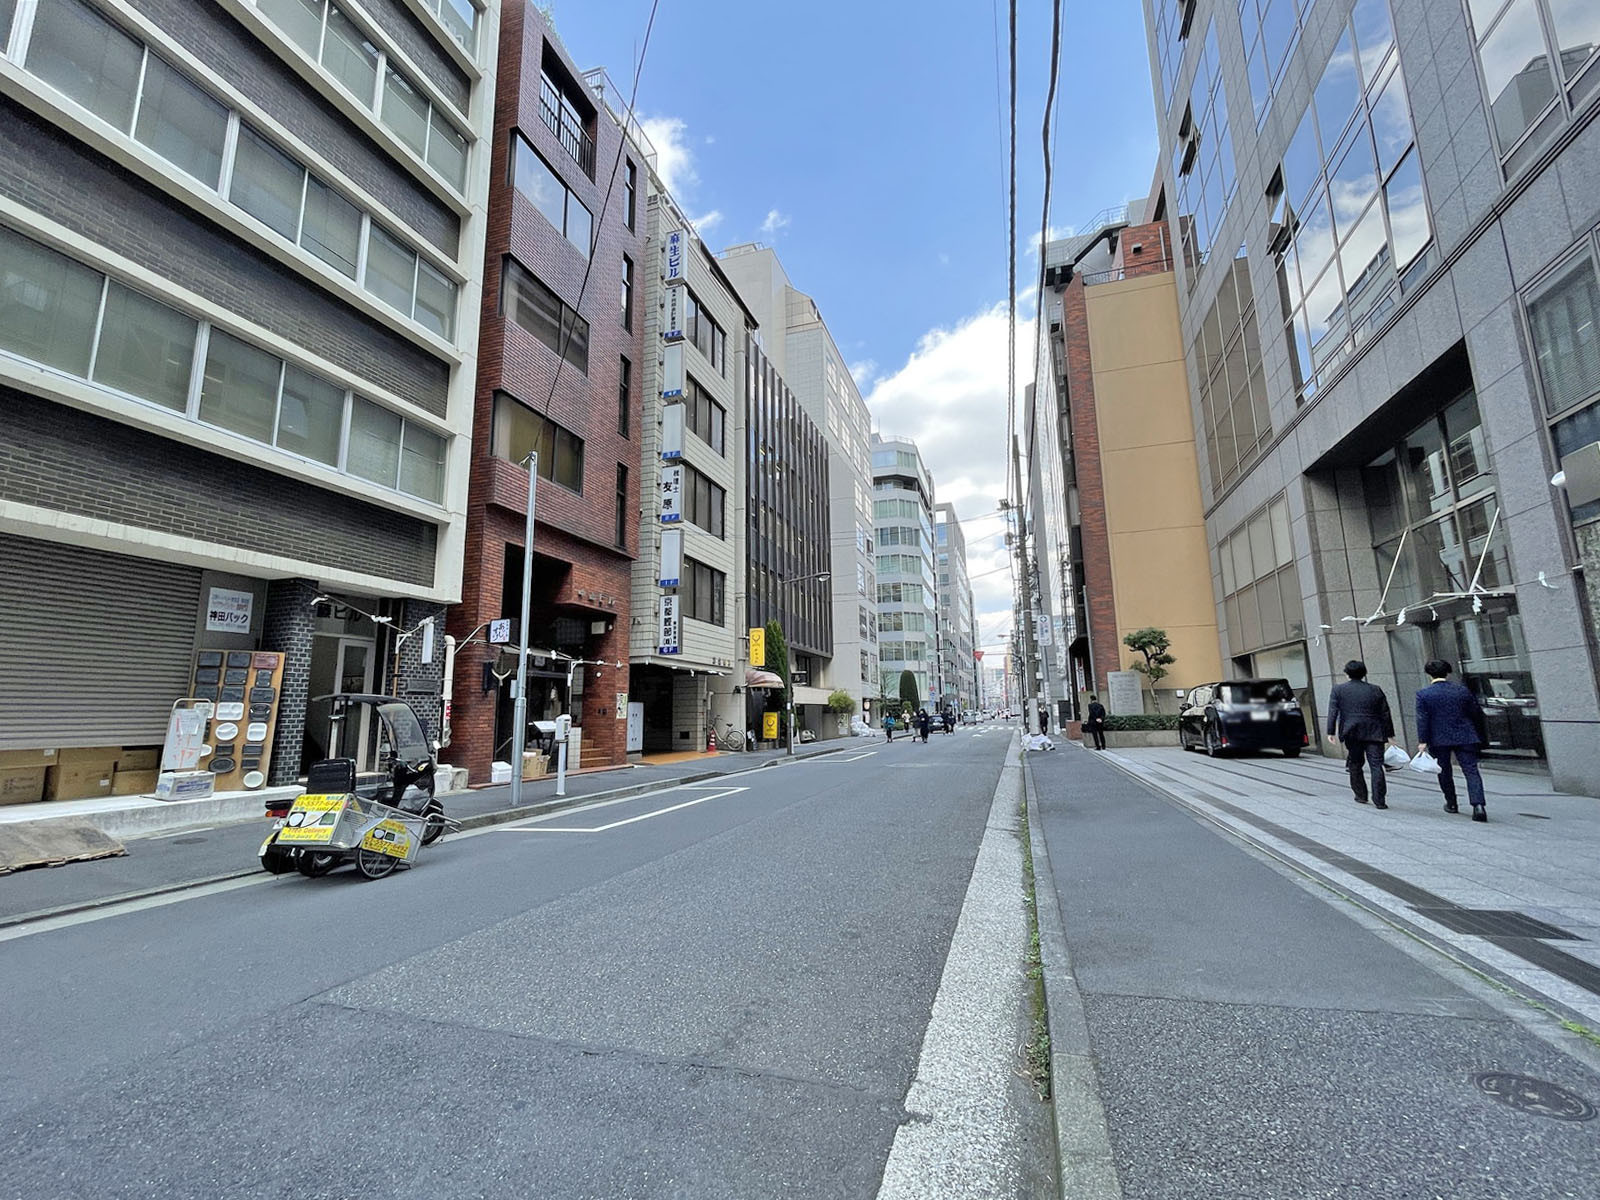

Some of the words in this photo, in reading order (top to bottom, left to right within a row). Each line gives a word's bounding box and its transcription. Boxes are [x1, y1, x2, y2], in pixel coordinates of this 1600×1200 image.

[670, 233, 681, 278] 麻生ビル
[209, 610, 249, 624] 神田パック
